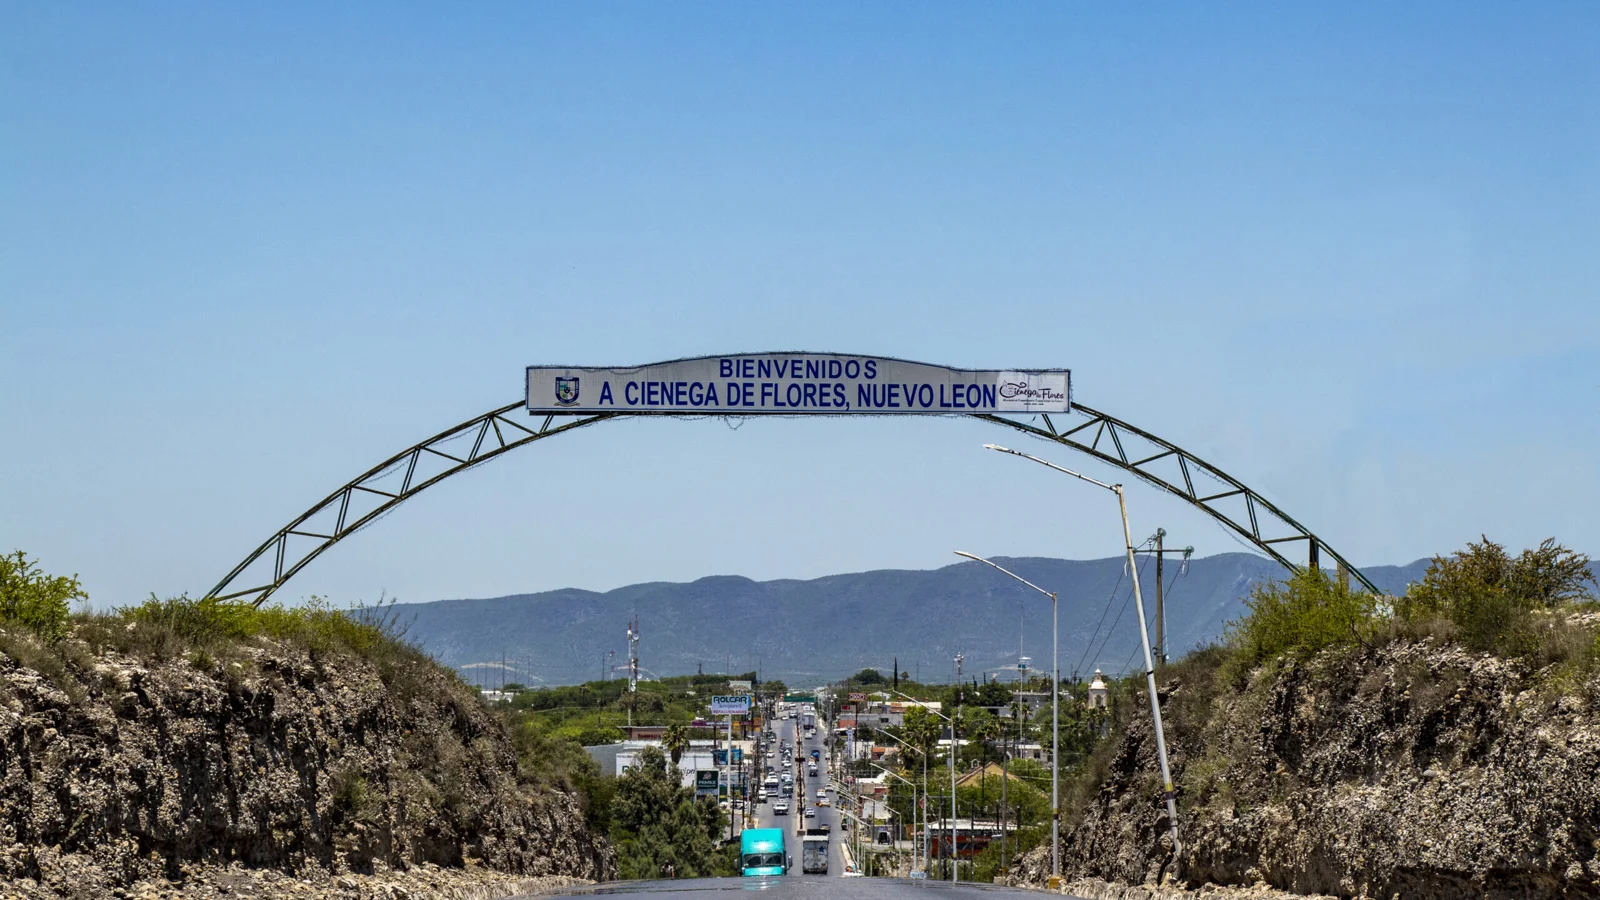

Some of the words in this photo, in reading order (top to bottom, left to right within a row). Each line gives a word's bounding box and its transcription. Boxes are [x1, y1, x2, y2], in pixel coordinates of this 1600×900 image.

[720, 358, 877, 379] BIENVENIDOS
[599, 381, 614, 405] A
[625, 381, 719, 406] CIENEGA
[727, 382, 754, 407] DE
[761, 382, 850, 411] FLORES,
[858, 383, 934, 408] NUEVO
[940, 384, 996, 408] LEON
[1038, 388, 1064, 399] Flores
[713, 696, 747, 704] ROLCAR
